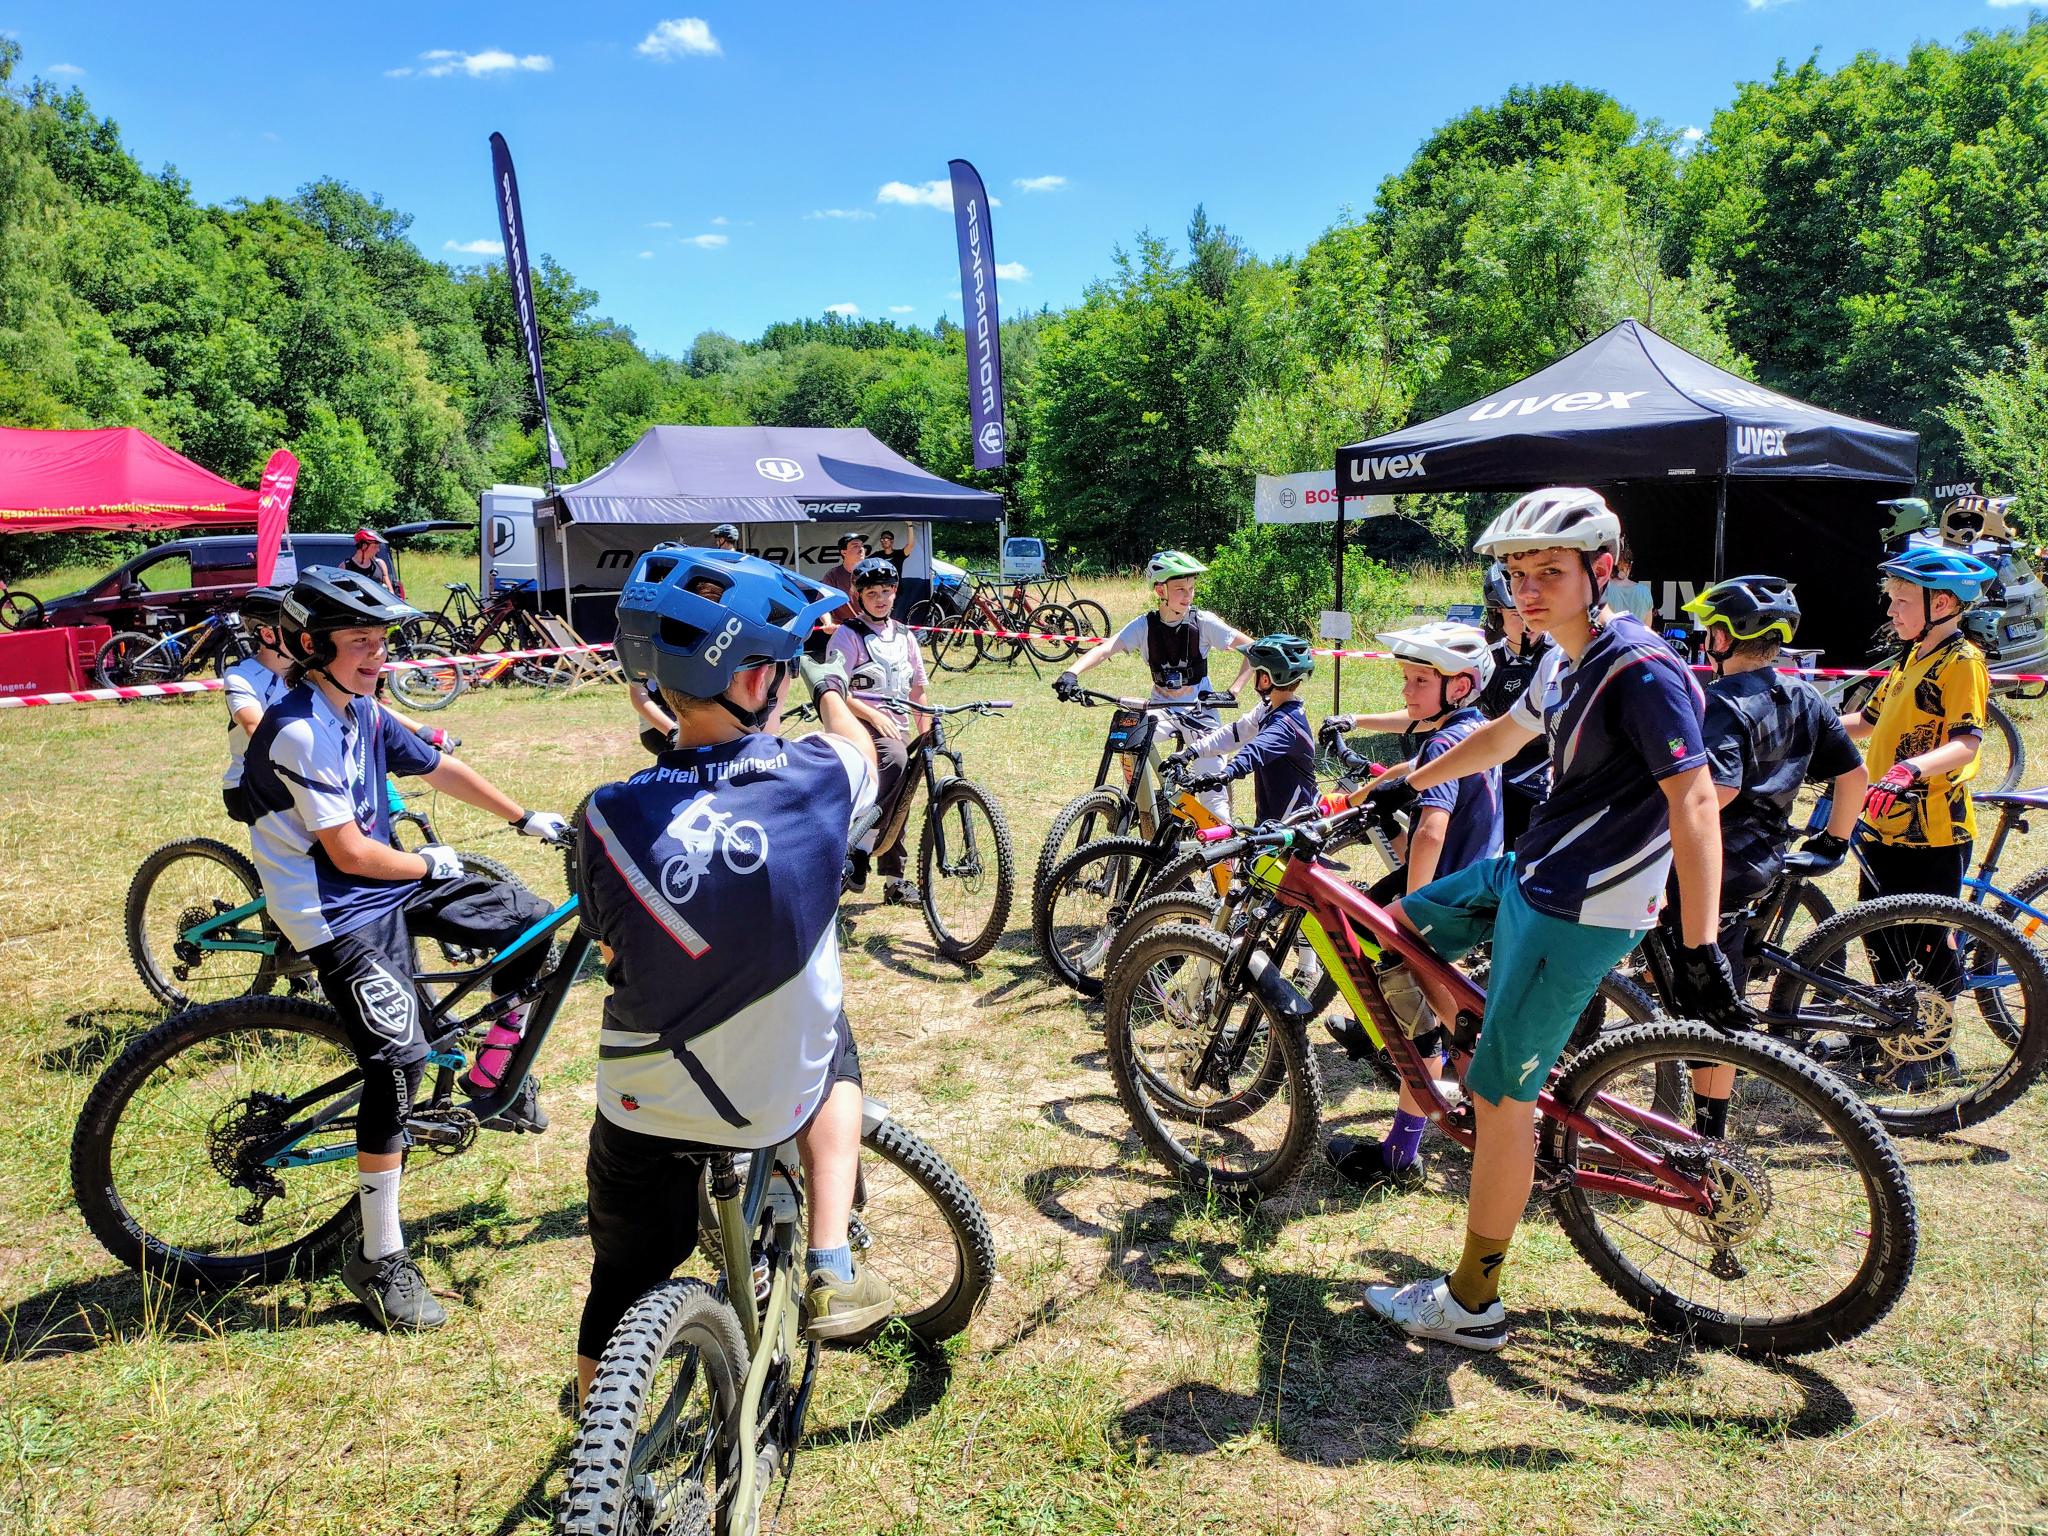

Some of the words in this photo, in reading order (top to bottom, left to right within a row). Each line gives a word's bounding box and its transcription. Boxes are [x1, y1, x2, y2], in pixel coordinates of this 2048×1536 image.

[1467, 391, 1649, 422] uvex
[1737, 426, 1787, 456] uvex
[1350, 451, 1427, 482] uvex
[1935, 482, 1978, 498] uvex
[704, 617, 742, 667] POC
[656, 767, 699, 784] Pfeil
[705, 753, 788, 782] Tübingen
[623, 864, 644, 890] MTB
[643, 888, 699, 943] Youngster
[391, 1067, 410, 1117] ORTEMA
[1865, 1176, 1898, 1298] SCHWALBE
[1694, 1306, 1729, 1325] SWISS
